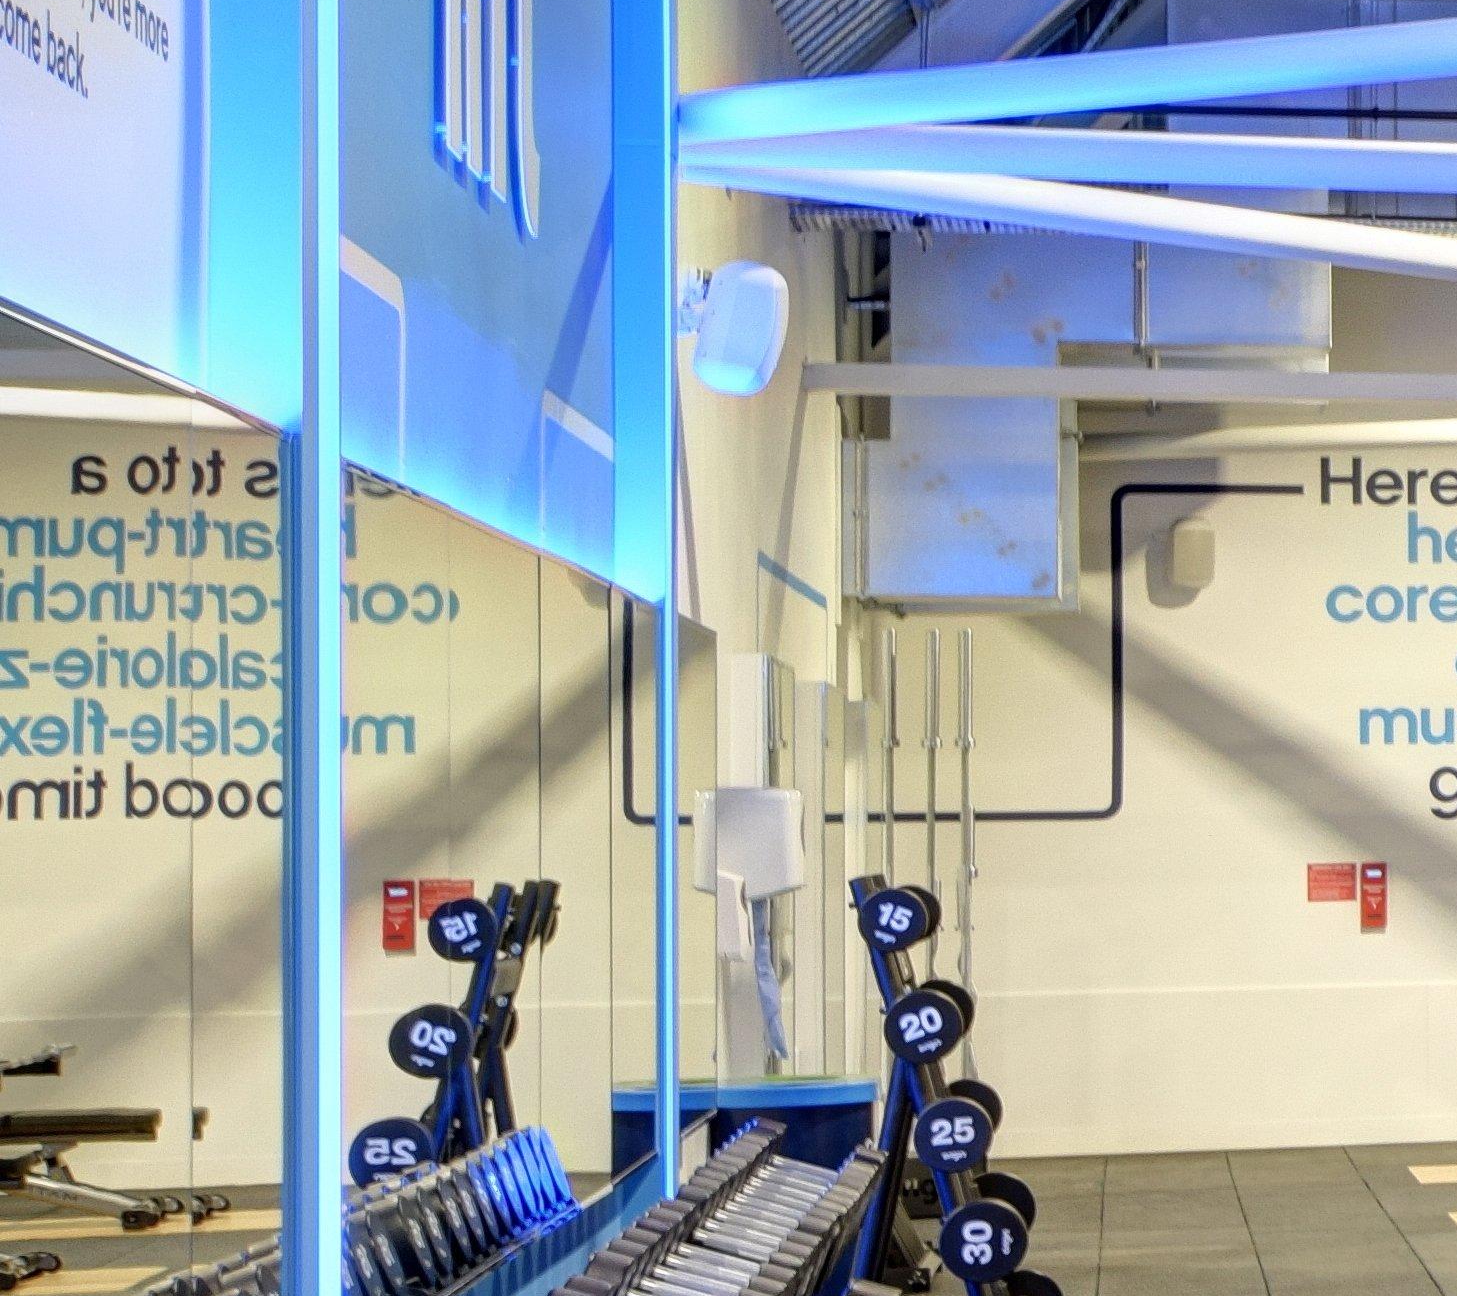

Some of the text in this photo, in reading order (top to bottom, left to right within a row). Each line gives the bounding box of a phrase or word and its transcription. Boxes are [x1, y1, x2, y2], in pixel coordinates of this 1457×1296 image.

[46, 8, 88, 99] back.
[879, 902, 913, 933] 15
[899, 1006, 943, 1043] 20
[930, 1116, 975, 1147] 25
[961, 1219, 993, 1265] 30
